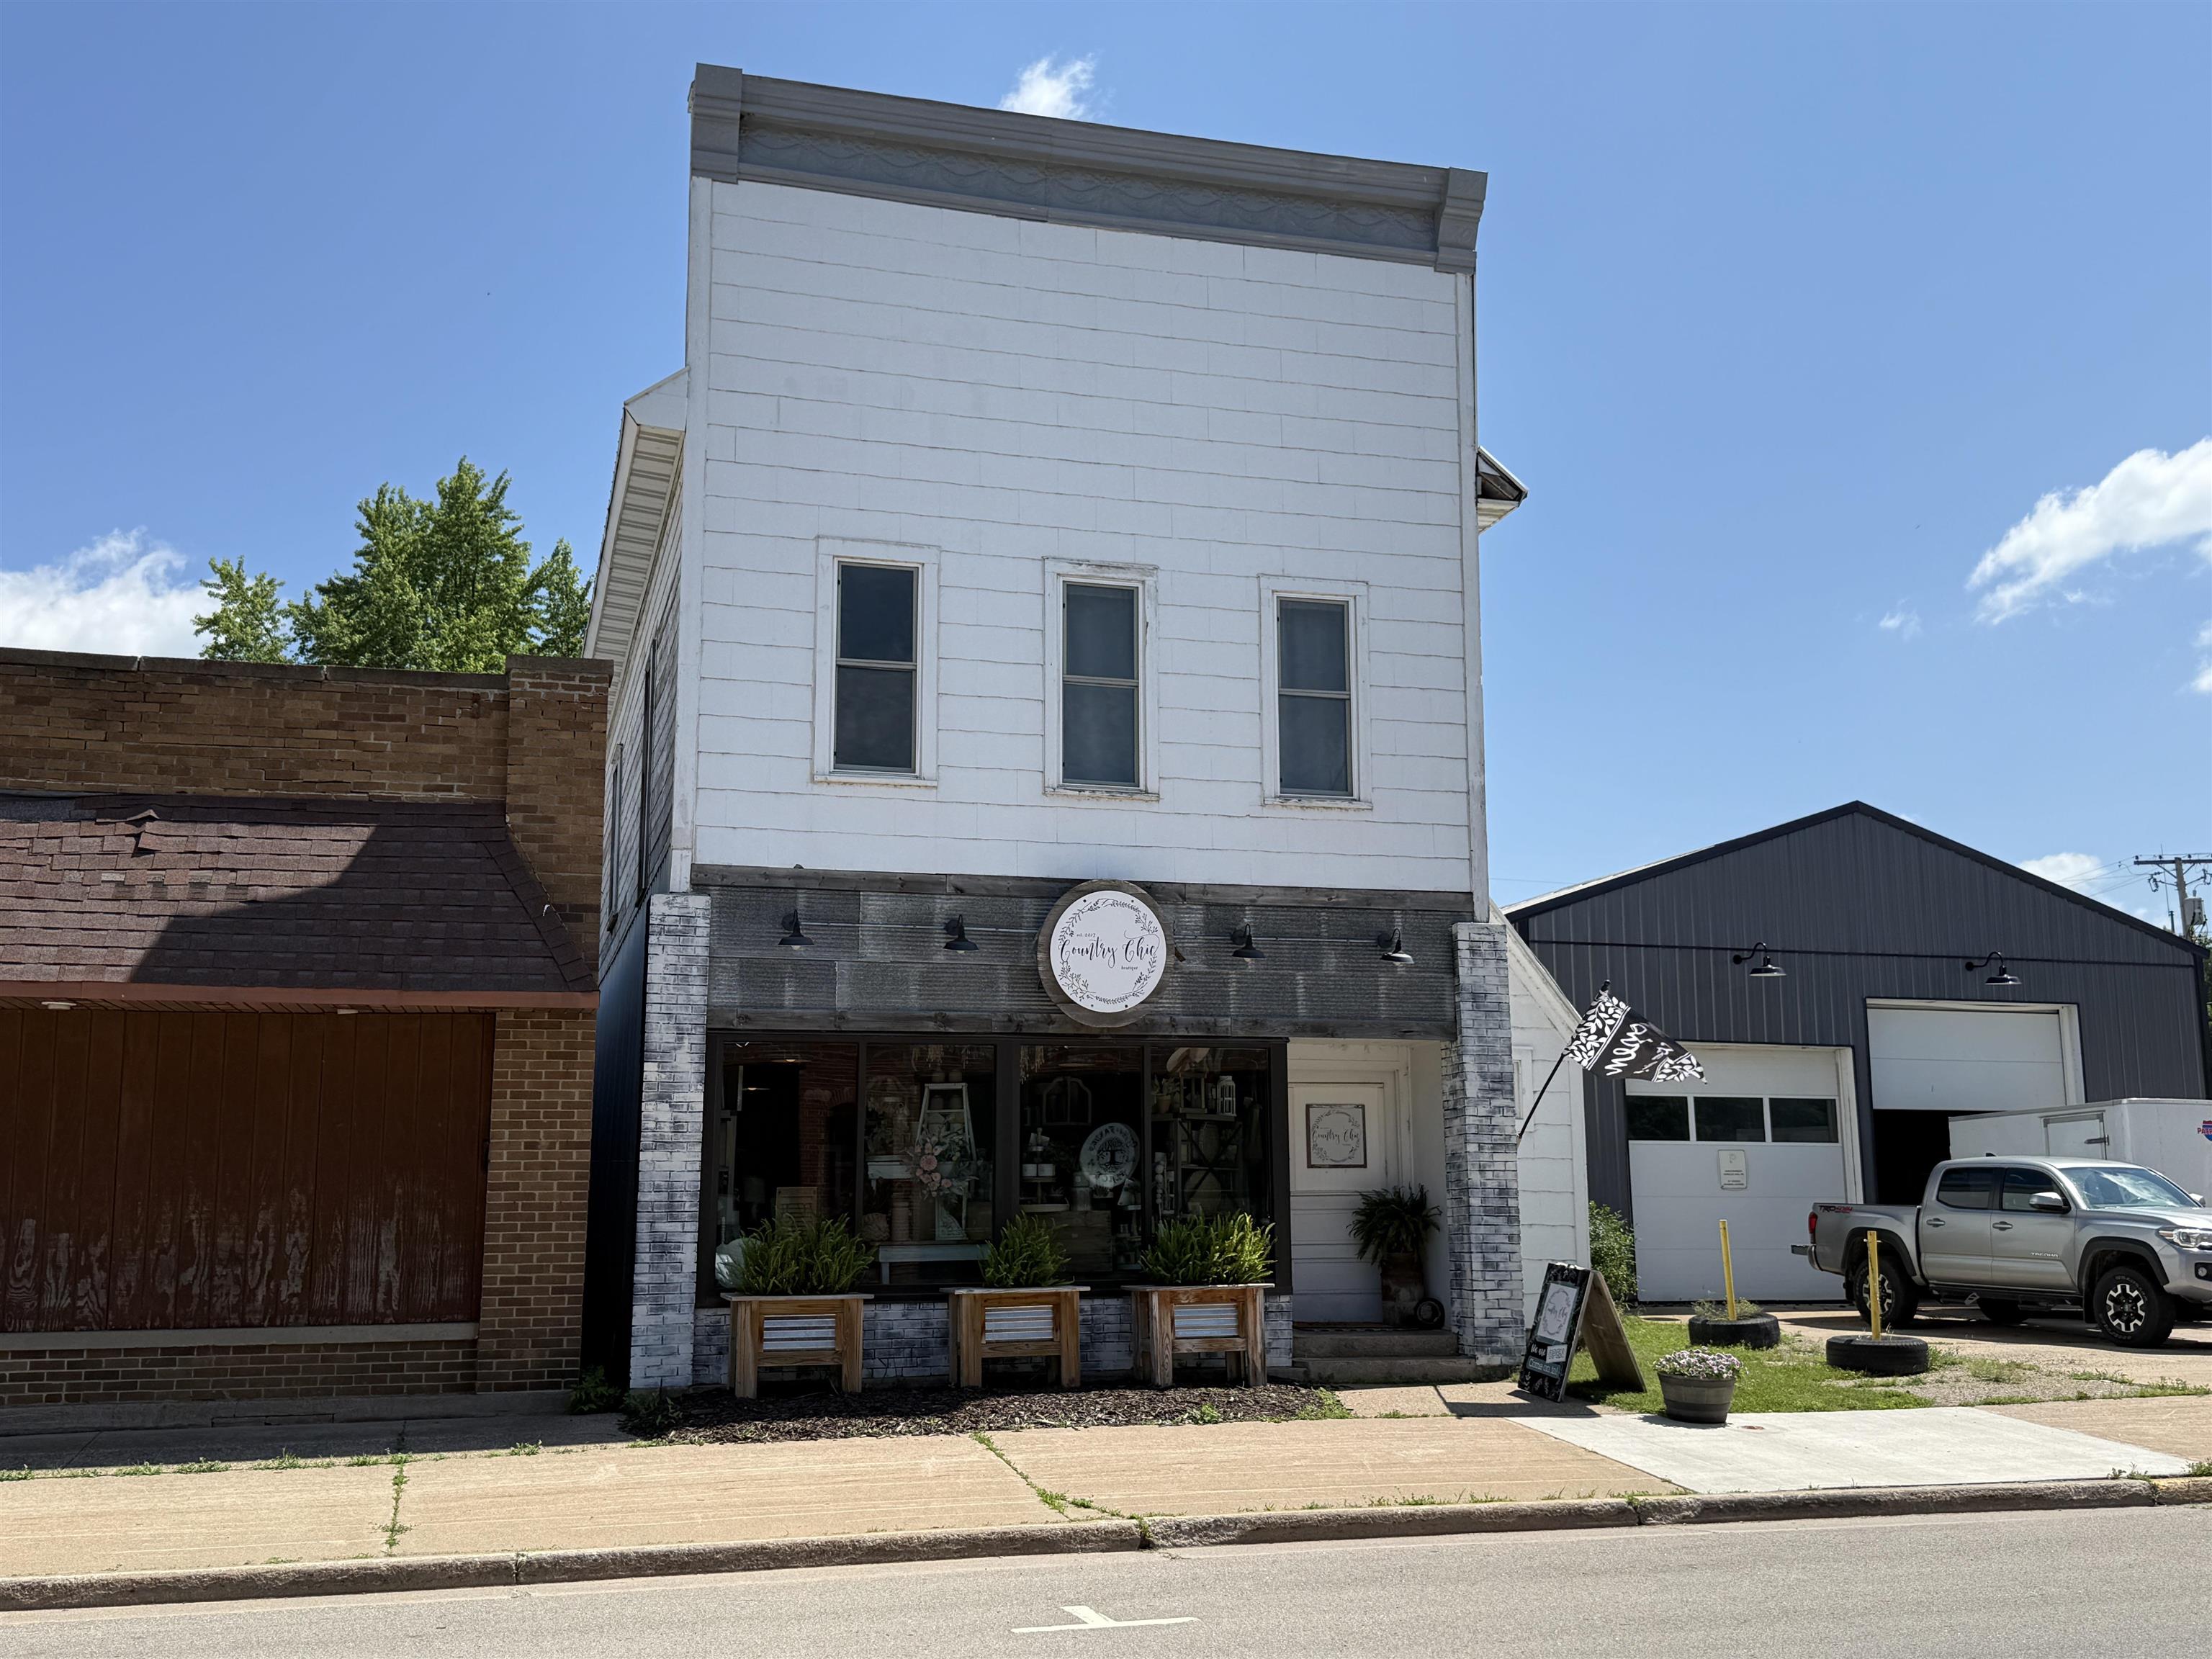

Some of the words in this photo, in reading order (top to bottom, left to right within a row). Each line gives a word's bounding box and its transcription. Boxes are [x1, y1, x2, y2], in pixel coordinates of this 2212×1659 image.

[1058, 936, 1118, 968] Country
[1123, 930, 1160, 963] Chic
[1312, 1128, 1340, 1145] Country
